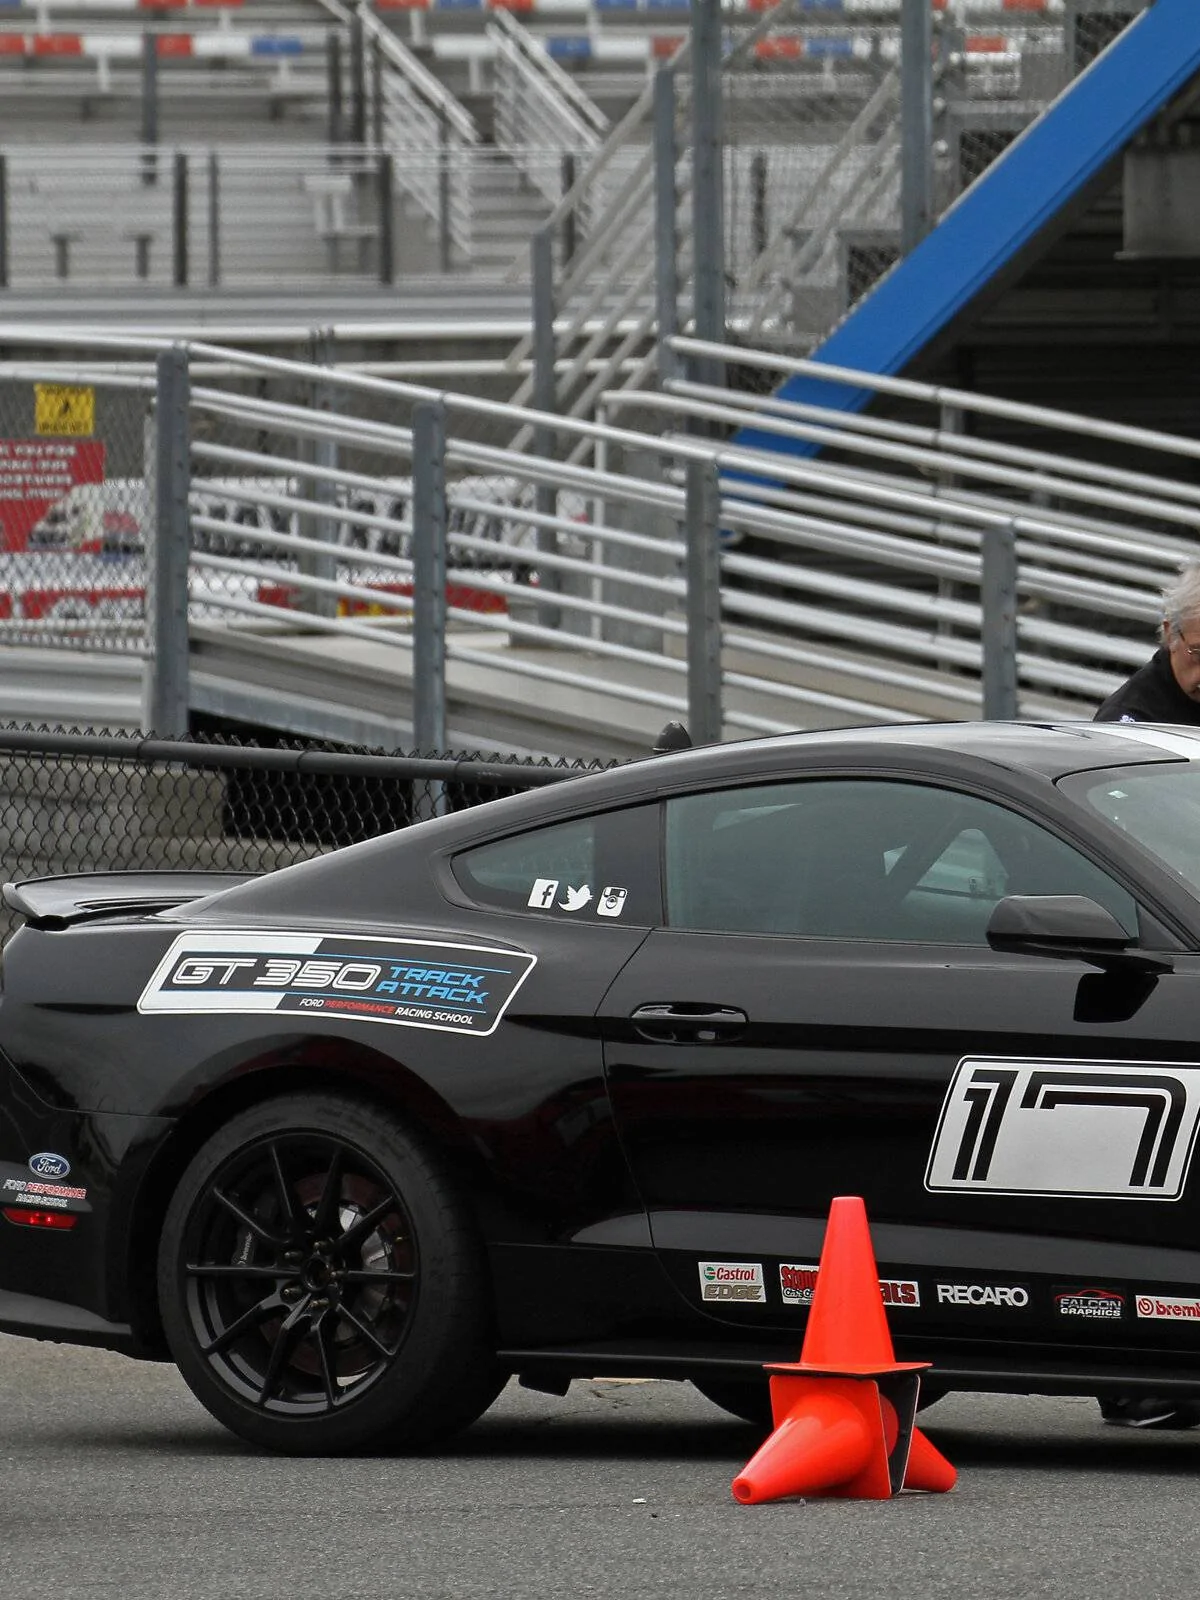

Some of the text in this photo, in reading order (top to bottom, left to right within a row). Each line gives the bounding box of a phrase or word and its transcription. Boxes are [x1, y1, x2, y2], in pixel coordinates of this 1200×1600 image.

[172, 958, 382, 991] GT 350
[389, 966, 485, 988] TRACK
[376, 981, 490, 1004] ATTACK
[300, 998, 473, 1025] FORD PERFORMANCE RACING SCHOOL
[952, 1070, 1188, 1188] 17
[37, 1158, 61, 1174] Ford
[717, 1267, 755, 1281] Castrol
[704, 1284, 763, 1300] EDGE
[937, 1284, 1028, 1306] RECARO
[1060, 1298, 1121, 1310] FALCON
[1060, 1307, 1121, 1317] GRAPHICS
